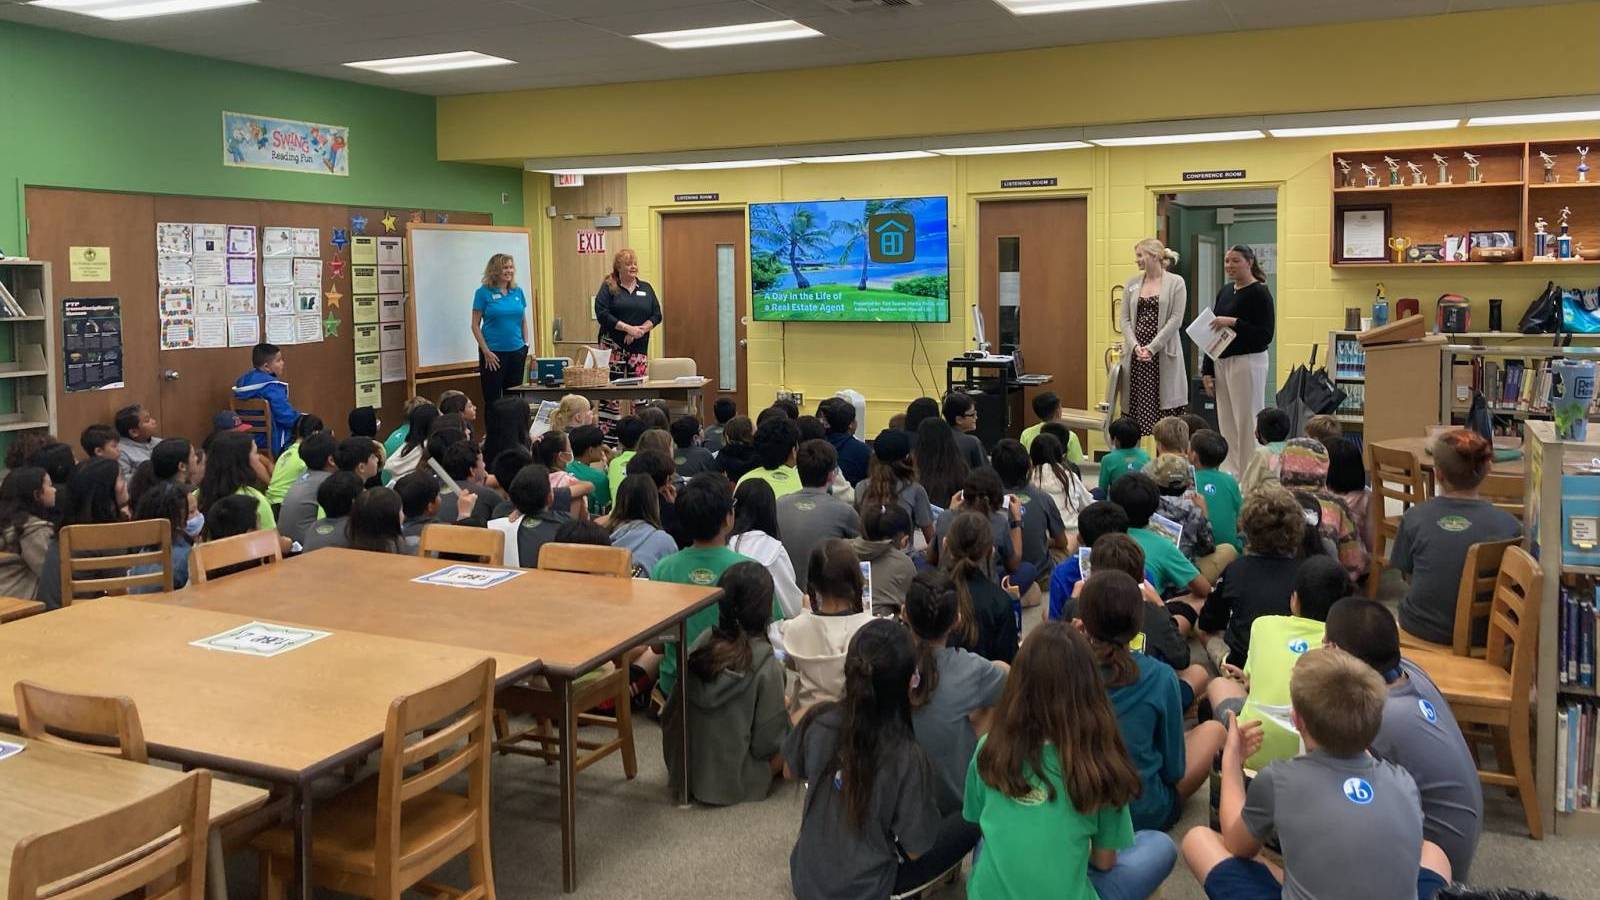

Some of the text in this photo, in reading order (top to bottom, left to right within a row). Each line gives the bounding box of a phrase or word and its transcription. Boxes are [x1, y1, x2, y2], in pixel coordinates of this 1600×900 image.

[272, 130, 309, 153] SWING
[271, 150, 299, 164] Reading
[579, 233, 604, 250] EXIT
[764, 292, 771, 300] A
[772, 292, 788, 302] Day
[799, 292, 814, 300] the
[815, 292, 831, 300] Life
[833, 292, 842, 300] of
[771, 303, 790, 311] Real
[791, 303, 818, 311] Estate
[819, 303, 845, 313] Agent
